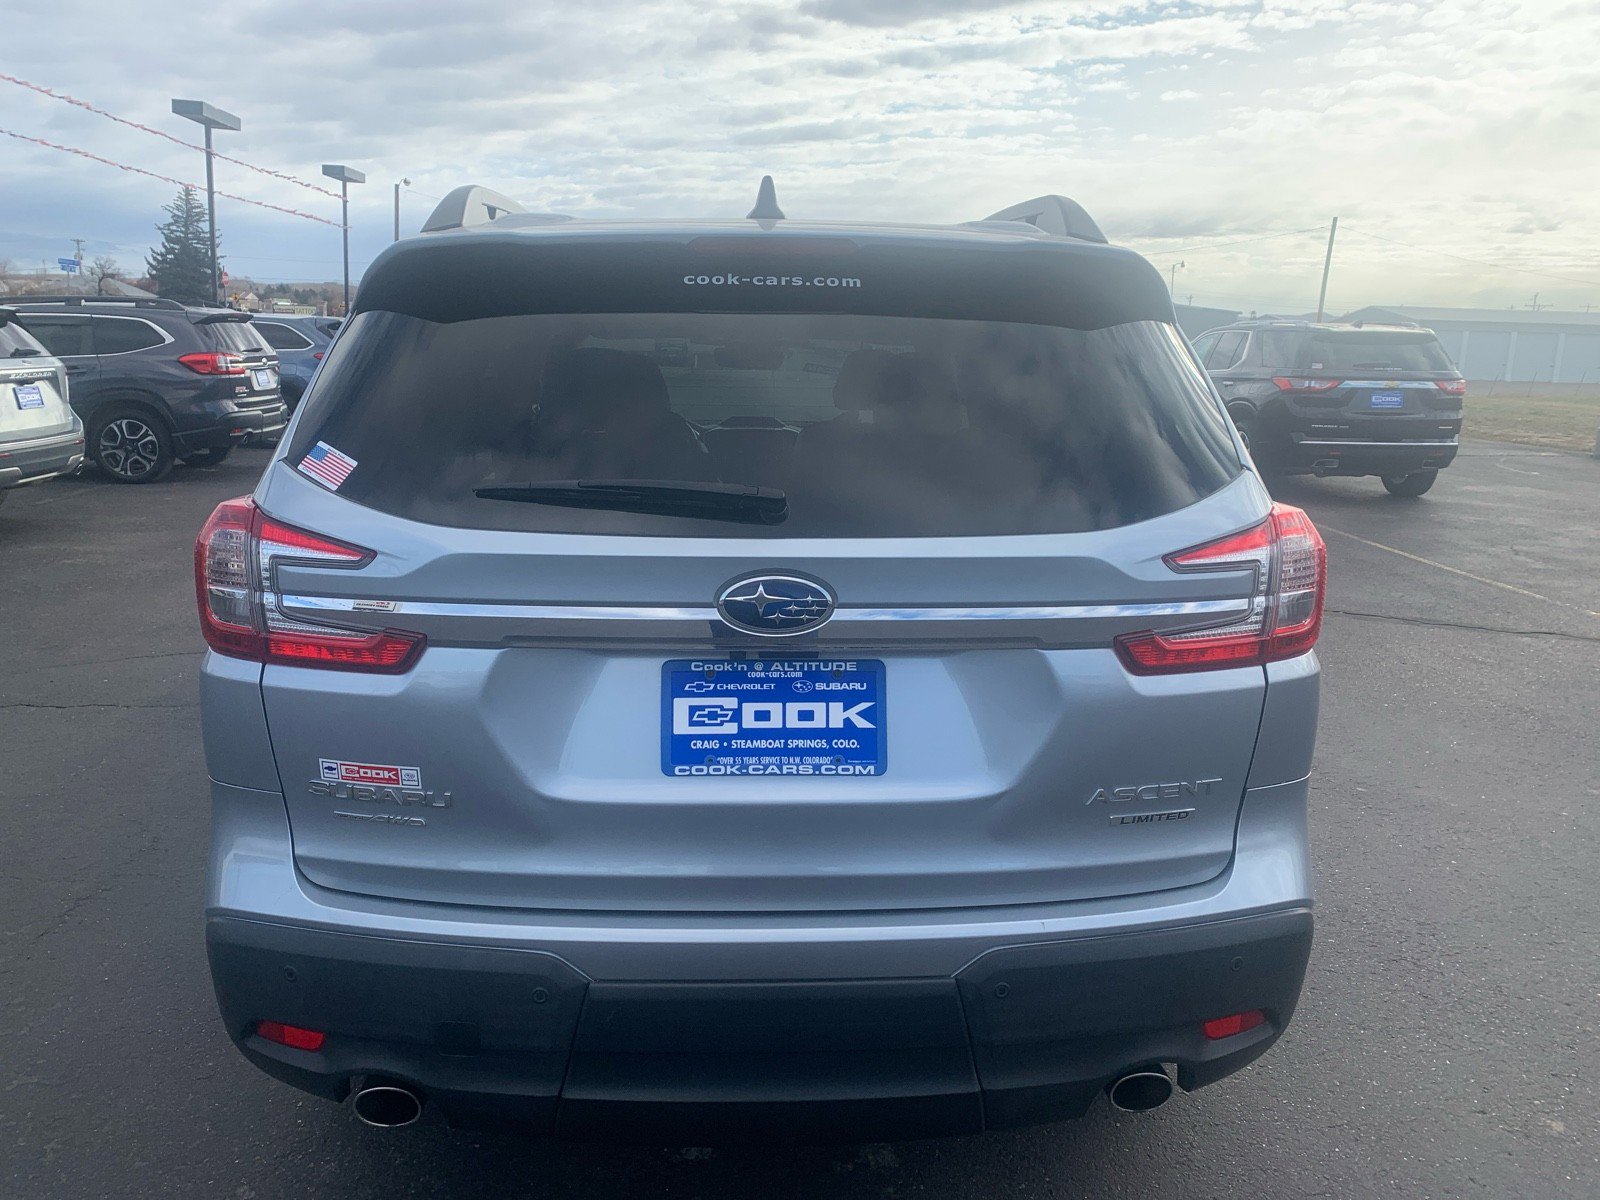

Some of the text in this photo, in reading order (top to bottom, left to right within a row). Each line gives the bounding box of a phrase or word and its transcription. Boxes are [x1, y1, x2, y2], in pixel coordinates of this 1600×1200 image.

[683, 273, 862, 288] cook-cars.com
[691, 662, 857, 671] Cook'n @ ALTITUDE
[815, 682, 867, 691] SUBARU
[673, 697, 876, 735] COOK
[690, 739, 860, 749] CRAIG STEAMBOAT SPRINGS, COLO.
[781, 756, 789, 764] TO
[789, 756, 802, 764] N.W.
[342, 766, 398, 779] COOK
[674, 765, 875, 775] COOK-CARS.COM
[308, 780, 452, 809] SUBARU
[1085, 778, 1223, 806] ASCENT
[1120, 810, 1190, 825] LIMITED
